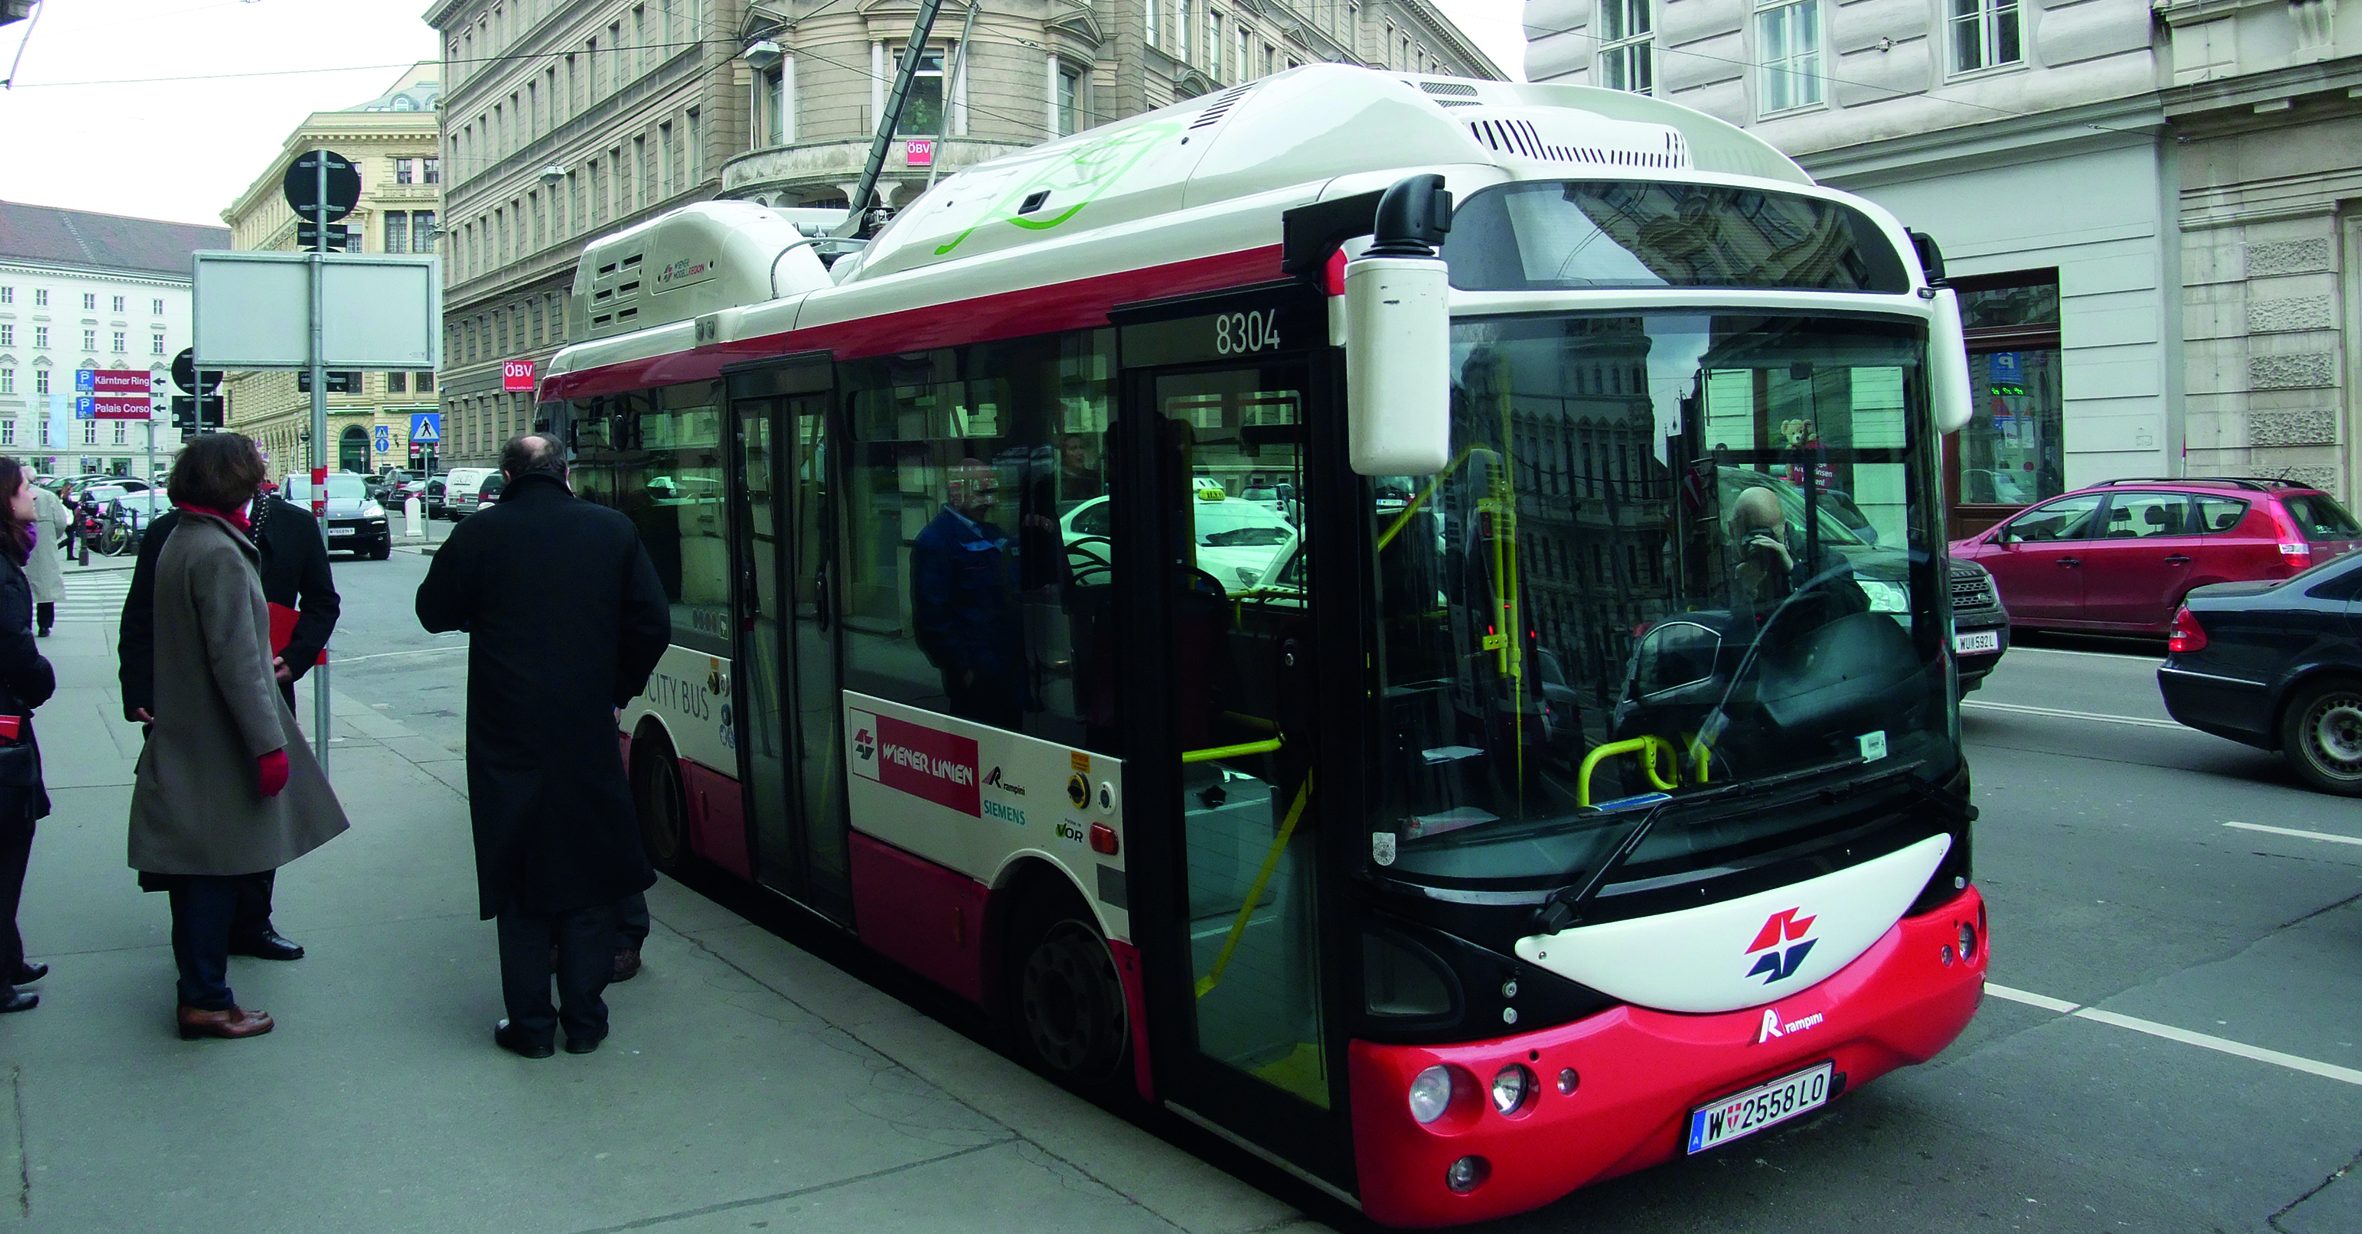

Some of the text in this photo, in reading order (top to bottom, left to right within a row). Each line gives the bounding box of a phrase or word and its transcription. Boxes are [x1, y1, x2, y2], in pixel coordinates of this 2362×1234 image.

[908, 142, 930, 153] ÖBV
[1216, 308, 1280, 354] 8304
[505, 362, 533, 377] ÖBV
[95, 376, 150, 386] Kärntner Ring
[95, 403, 150, 413] Palais Corso
[681, 680, 709, 721] BUS
[882, 742, 974, 787] WIENER LINIEN
[1003, 782, 1026, 796] rampini
[983, 799, 1026, 826] SIEMENS
[1056, 822, 1084, 843] VOR
[1785, 1012, 1823, 1034] rampini
